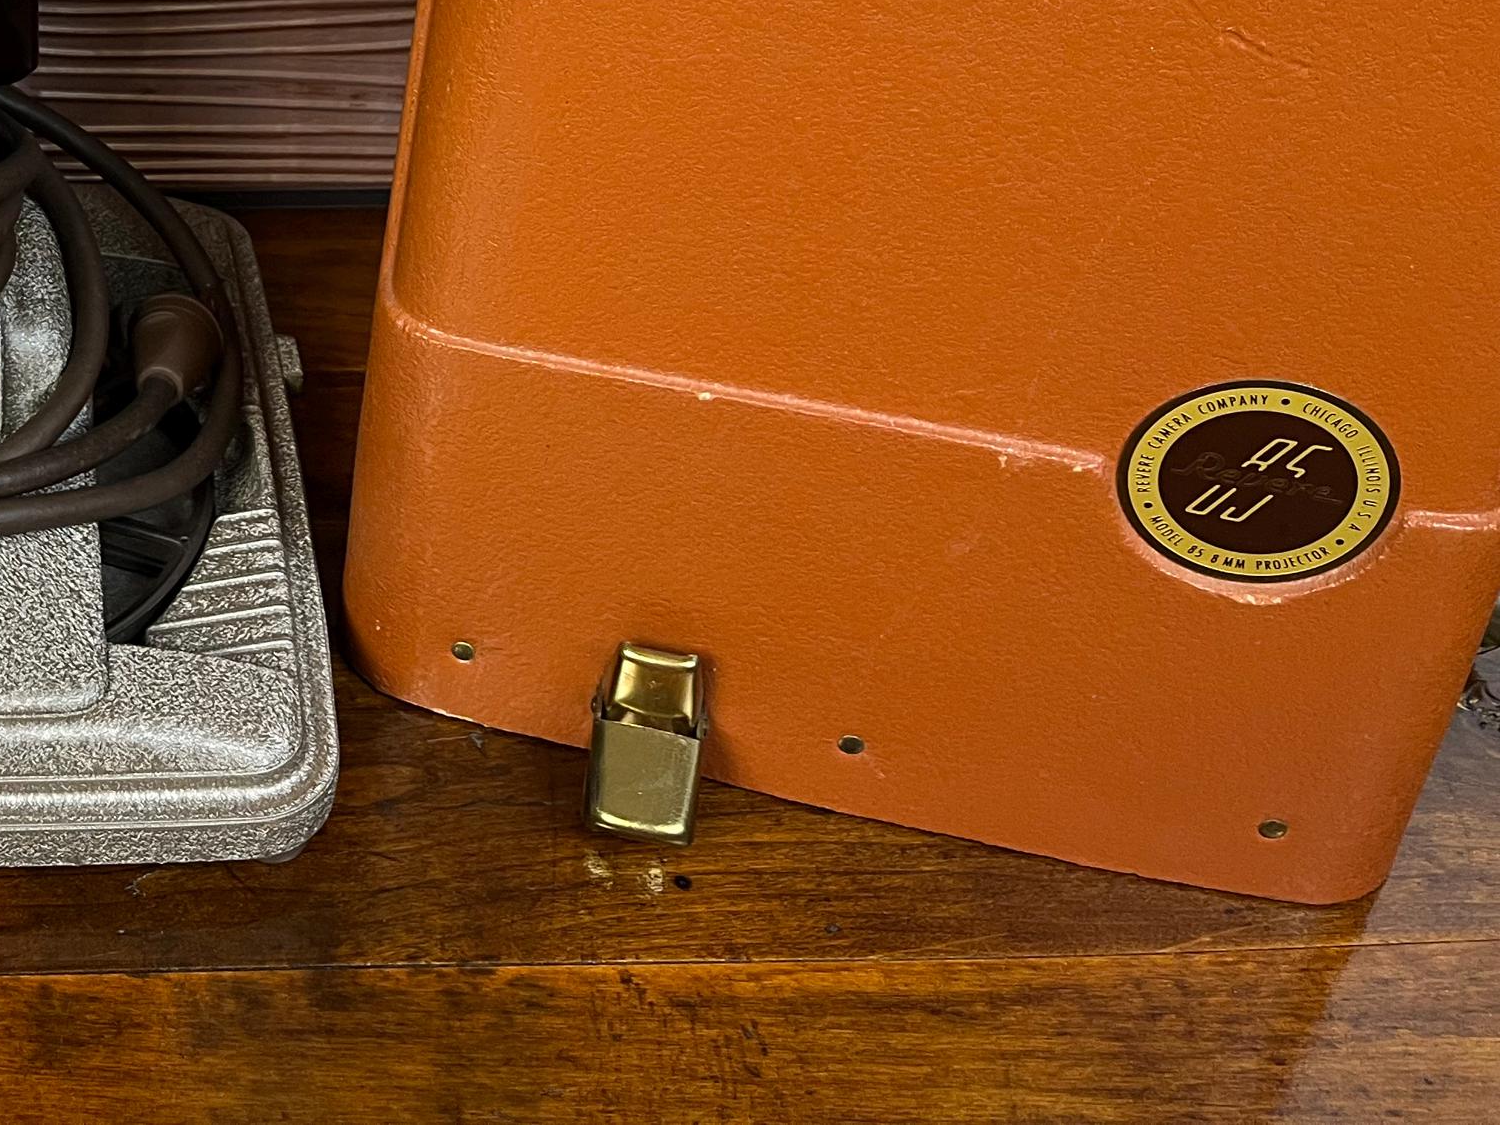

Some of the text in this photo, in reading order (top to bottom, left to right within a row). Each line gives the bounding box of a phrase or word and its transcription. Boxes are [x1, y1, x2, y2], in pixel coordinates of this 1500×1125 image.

[1137, 454, 1155, 493] REVERE
[1147, 414, 1192, 449] CAMERA
[1197, 395, 1269, 415] COMPANY
[1356, 445, 1382, 494] ILLINOIS
[1150, 516, 1181, 547] MODEL
[1187, 545, 1204, 557] 85
[1256, 546, 1330, 571] PROJECTOR
